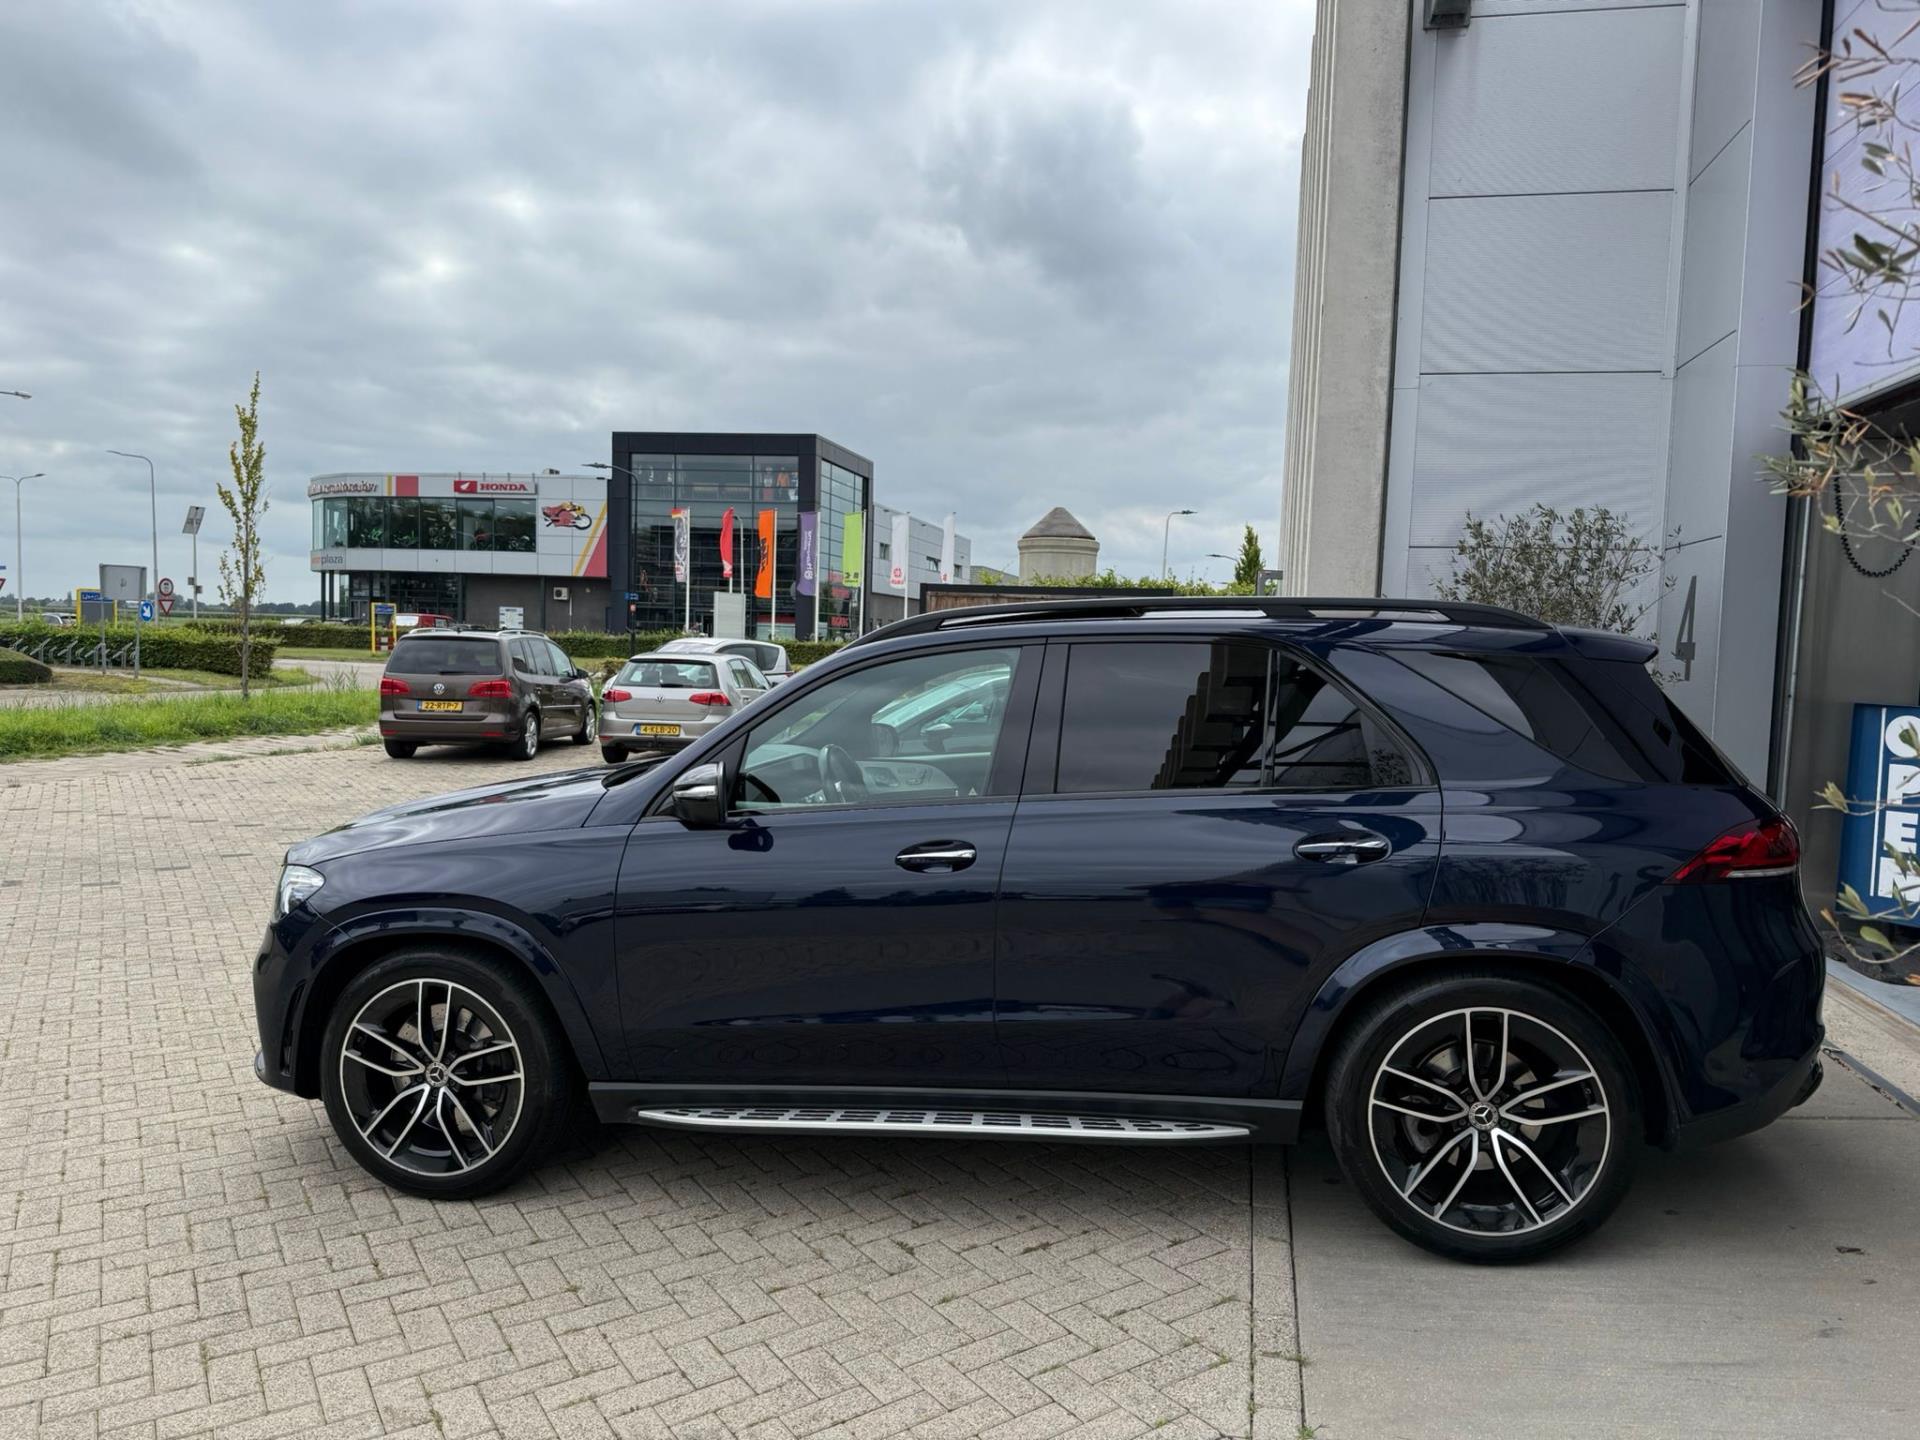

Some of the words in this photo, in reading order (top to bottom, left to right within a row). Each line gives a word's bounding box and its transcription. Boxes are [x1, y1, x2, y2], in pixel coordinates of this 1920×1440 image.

[479, 483, 529, 492] HONDA
[1675, 575, 1697, 682] 4
[424, 701, 460, 710] 22-RTP-7
